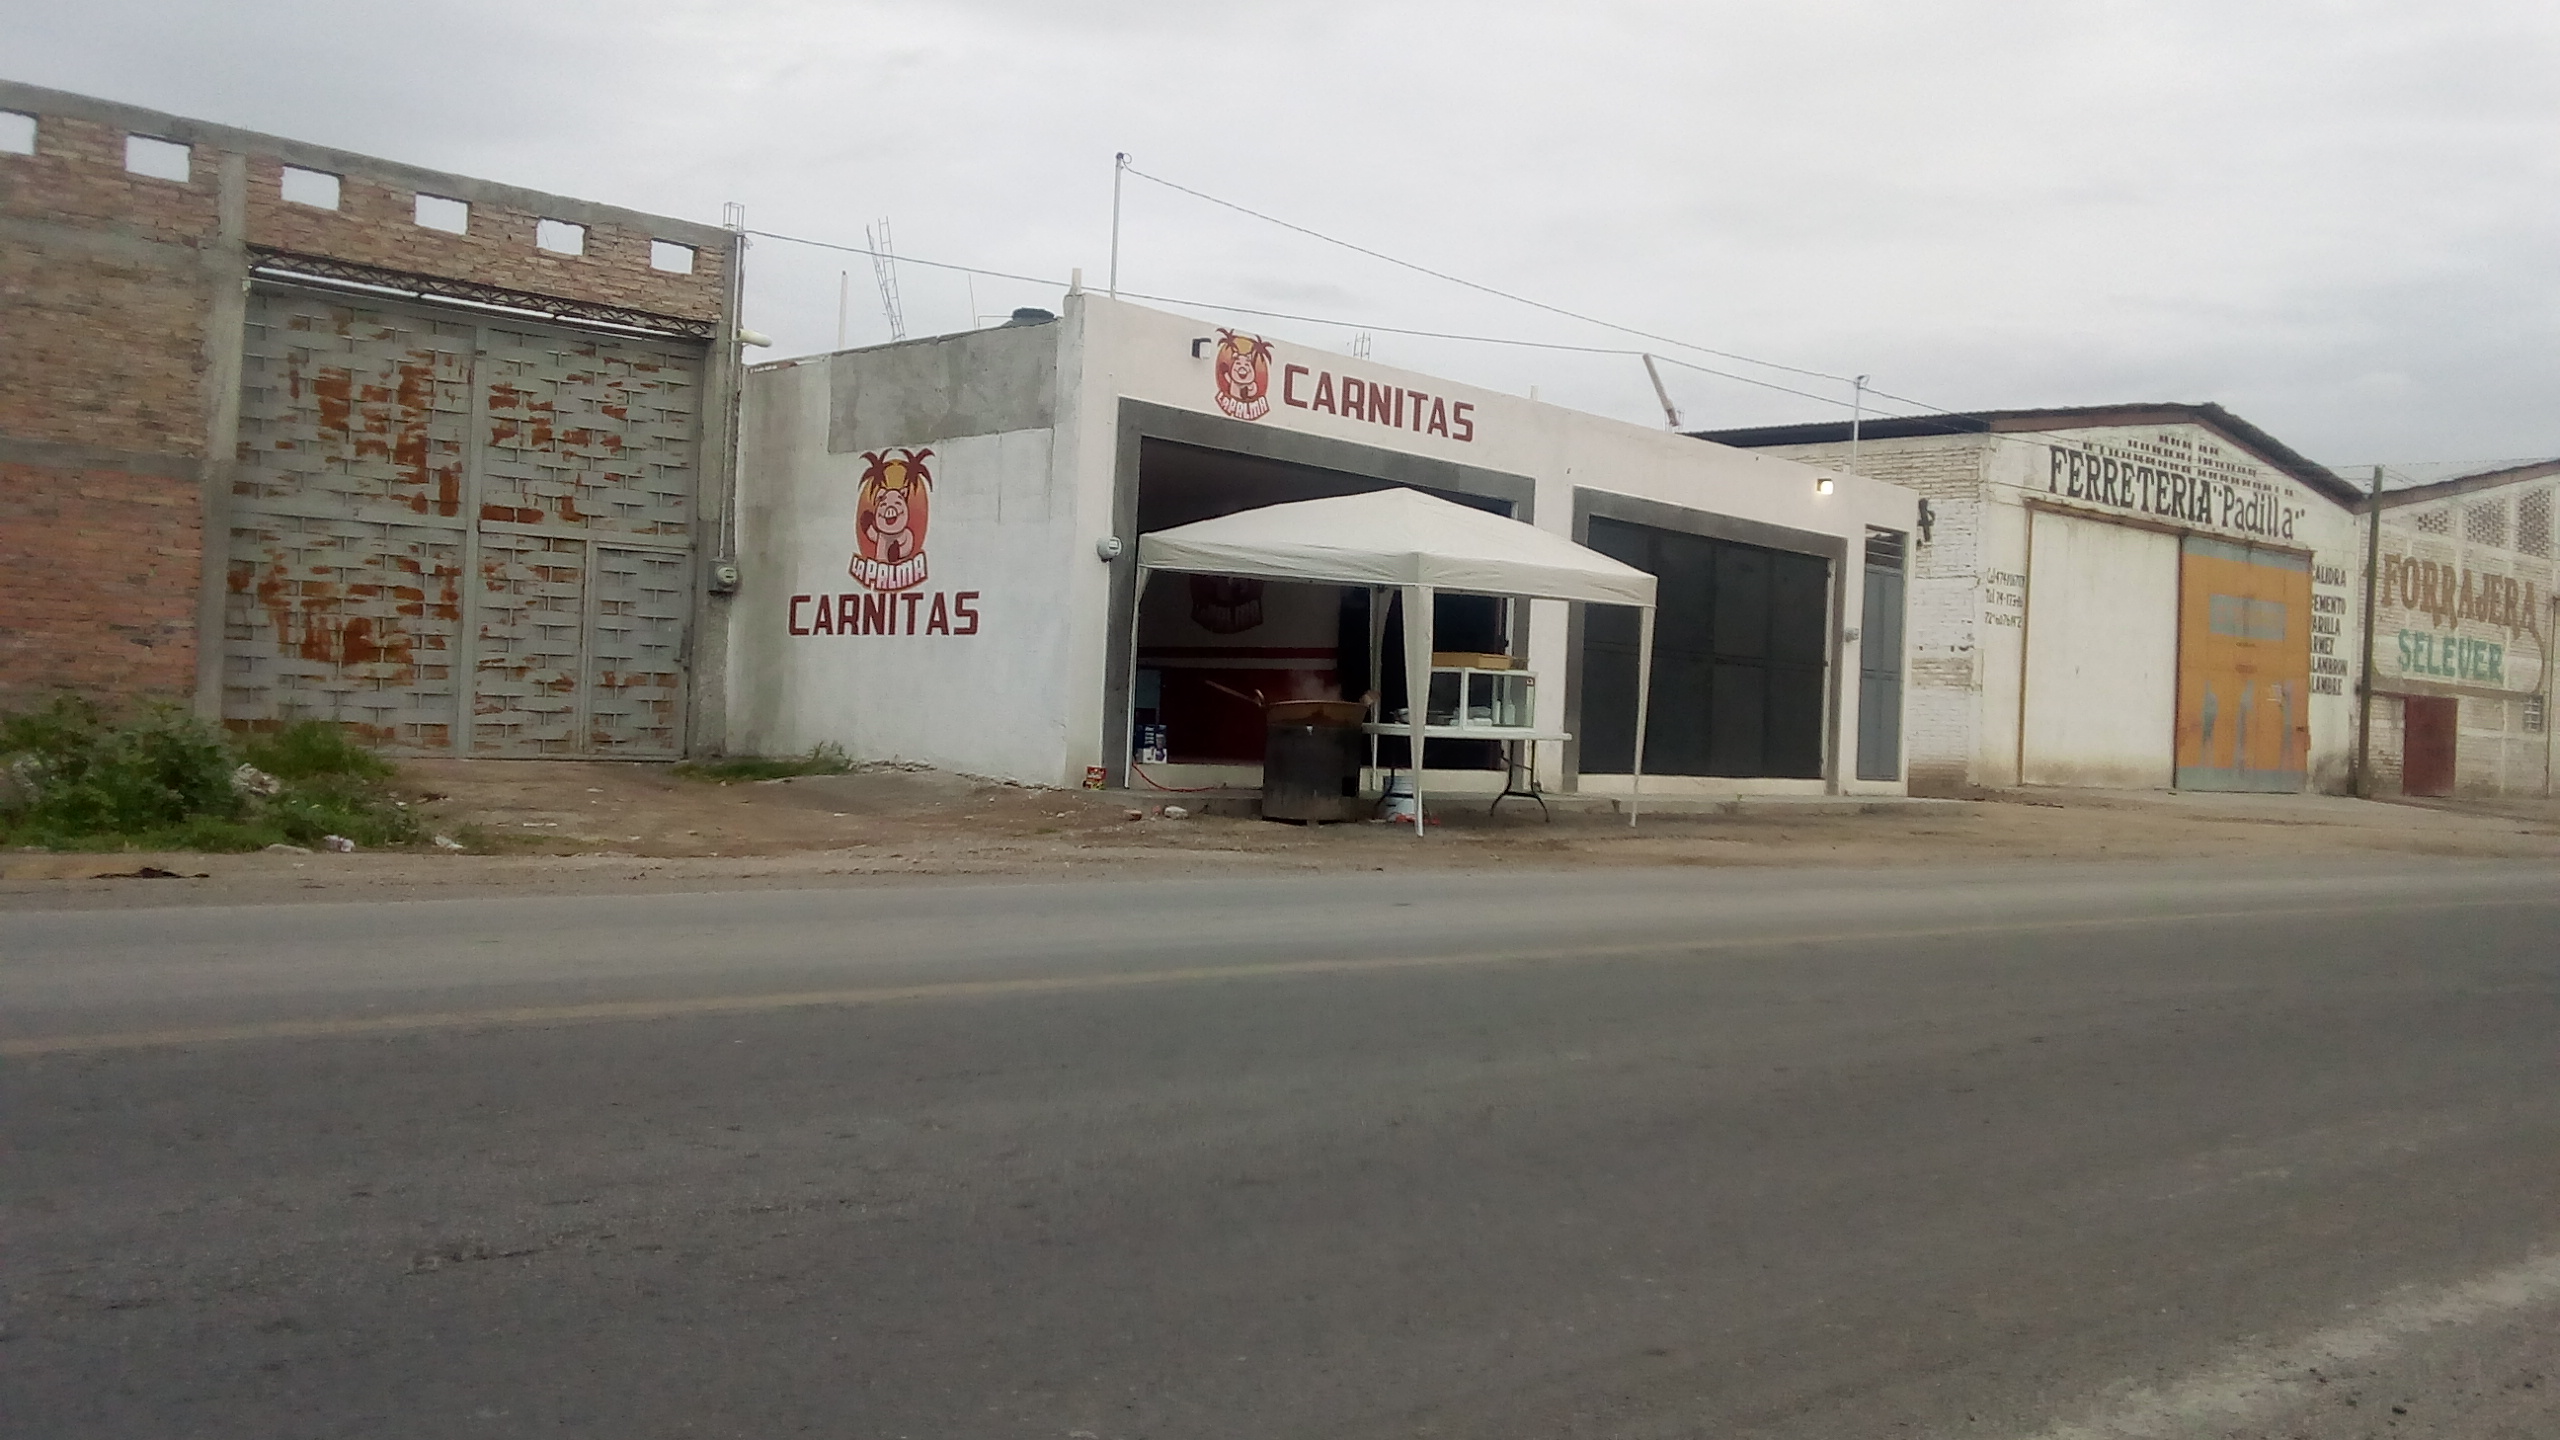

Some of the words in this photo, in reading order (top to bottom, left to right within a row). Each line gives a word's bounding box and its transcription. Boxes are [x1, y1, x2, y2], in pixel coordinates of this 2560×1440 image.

[1227, 396, 1268, 420] PALMA
[1283, 363, 1475, 442] CARNITAS
[2048, 446, 2212, 525] FERRETERIA
[851, 556, 865, 581] LA
[865, 553, 926, 589] PALMA
[2313, 565, 2347, 588] ALIDRA
[789, 591, 981, 637] CARNITAS
[2312, 594, 2347, 616] EMENTO
[2380, 552, 2540, 640] FORRAJERA
[2312, 615, 2342, 637] ARILLA
[2397, 628, 2505, 685] SELEVER
[2312, 675, 2343, 696] LAMBRE
